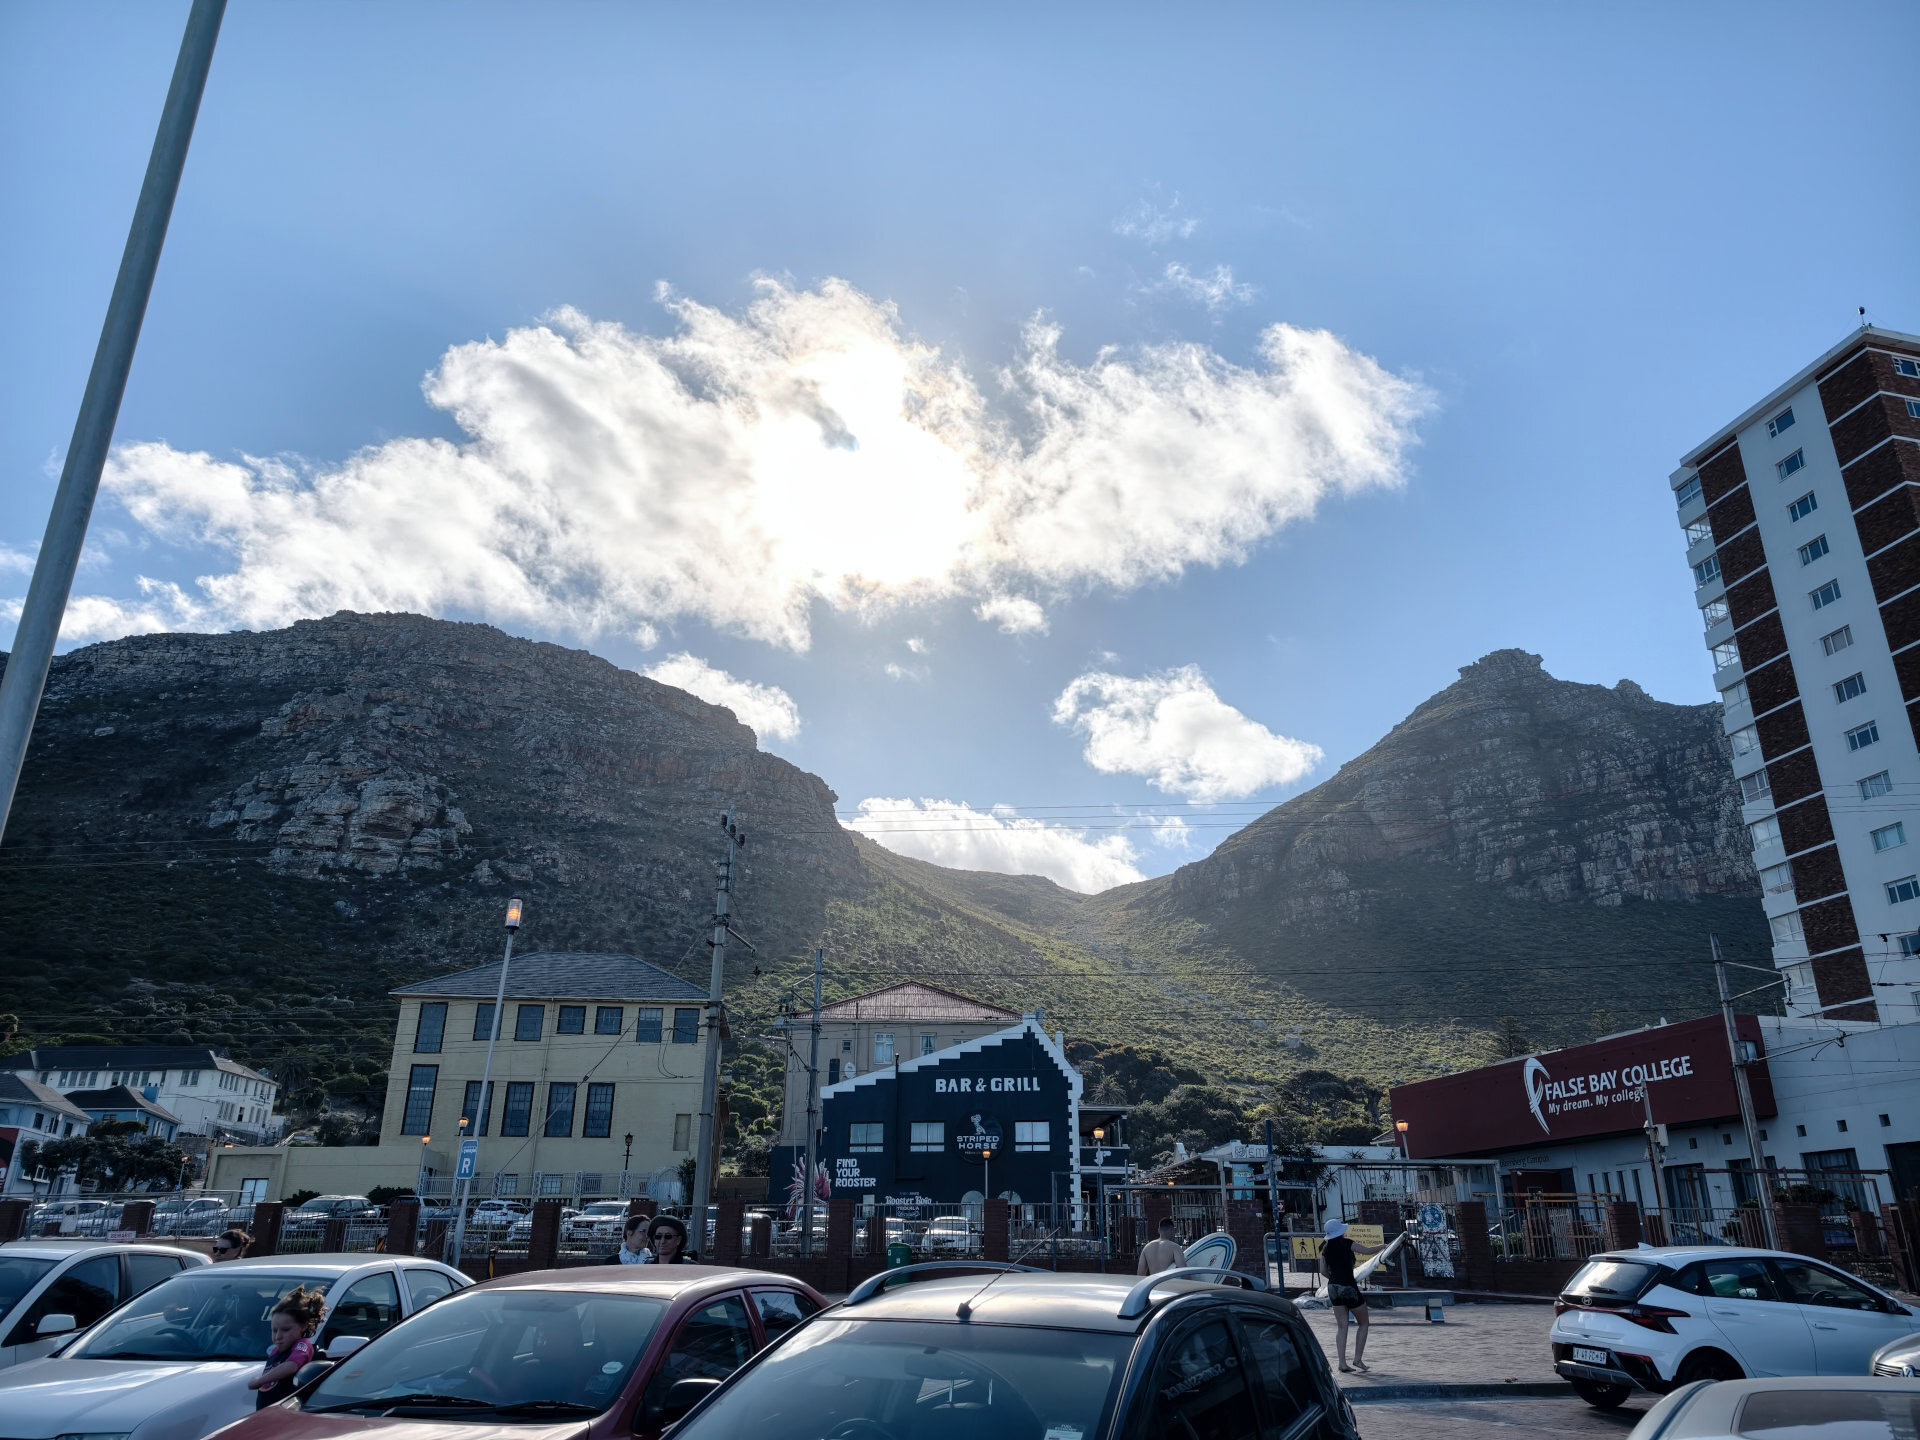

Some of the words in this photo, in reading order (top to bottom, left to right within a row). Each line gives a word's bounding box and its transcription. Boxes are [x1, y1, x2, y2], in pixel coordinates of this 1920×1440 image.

[1544, 1076, 1587, 1101] FALSE
[1588, 1070, 1618, 1093] BAY
[1621, 1055, 1694, 1088] COLLEGE
[935, 1077, 972, 1093] BAR
[975, 1077, 988, 1092] &
[990, 1076, 1041, 1092] GRILL
[1548, 1103, 1560, 1115] My
[1563, 1097, 1594, 1112] dream.
[1595, 1093, 1608, 1107] My
[956, 1135, 1000, 1143] STRIPED
[958, 1142, 998, 1150] HORSE
[461, 1157, 471, 1174] R
[836, 1158, 858, 1168] FIND
[836, 1168, 861, 1178] YOUR
[835, 1177, 877, 1188] ROOSTER
[885, 1195, 914, 1205] Rooster
